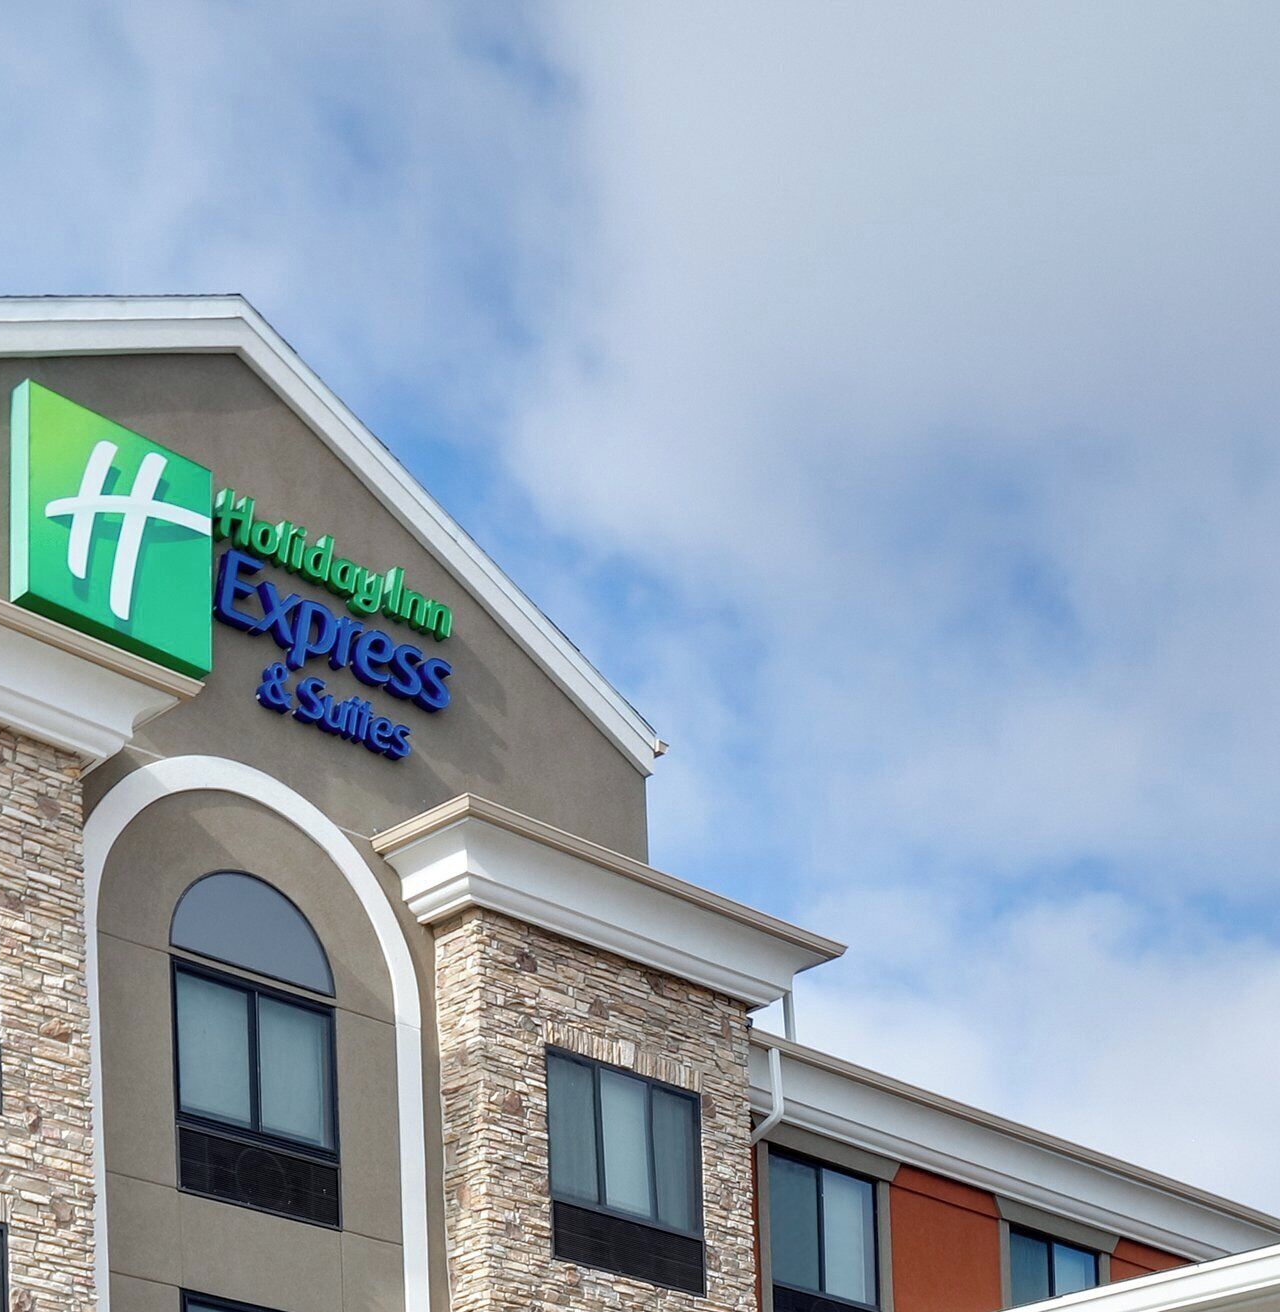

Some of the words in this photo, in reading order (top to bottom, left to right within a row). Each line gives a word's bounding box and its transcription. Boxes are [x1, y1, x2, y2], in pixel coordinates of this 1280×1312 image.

[214, 488, 384, 617] Holiday
[382, 567, 452, 642] Inn
[214, 549, 451, 714] Express
[256, 662, 292, 714] &
[292, 676, 411, 761] Suites
